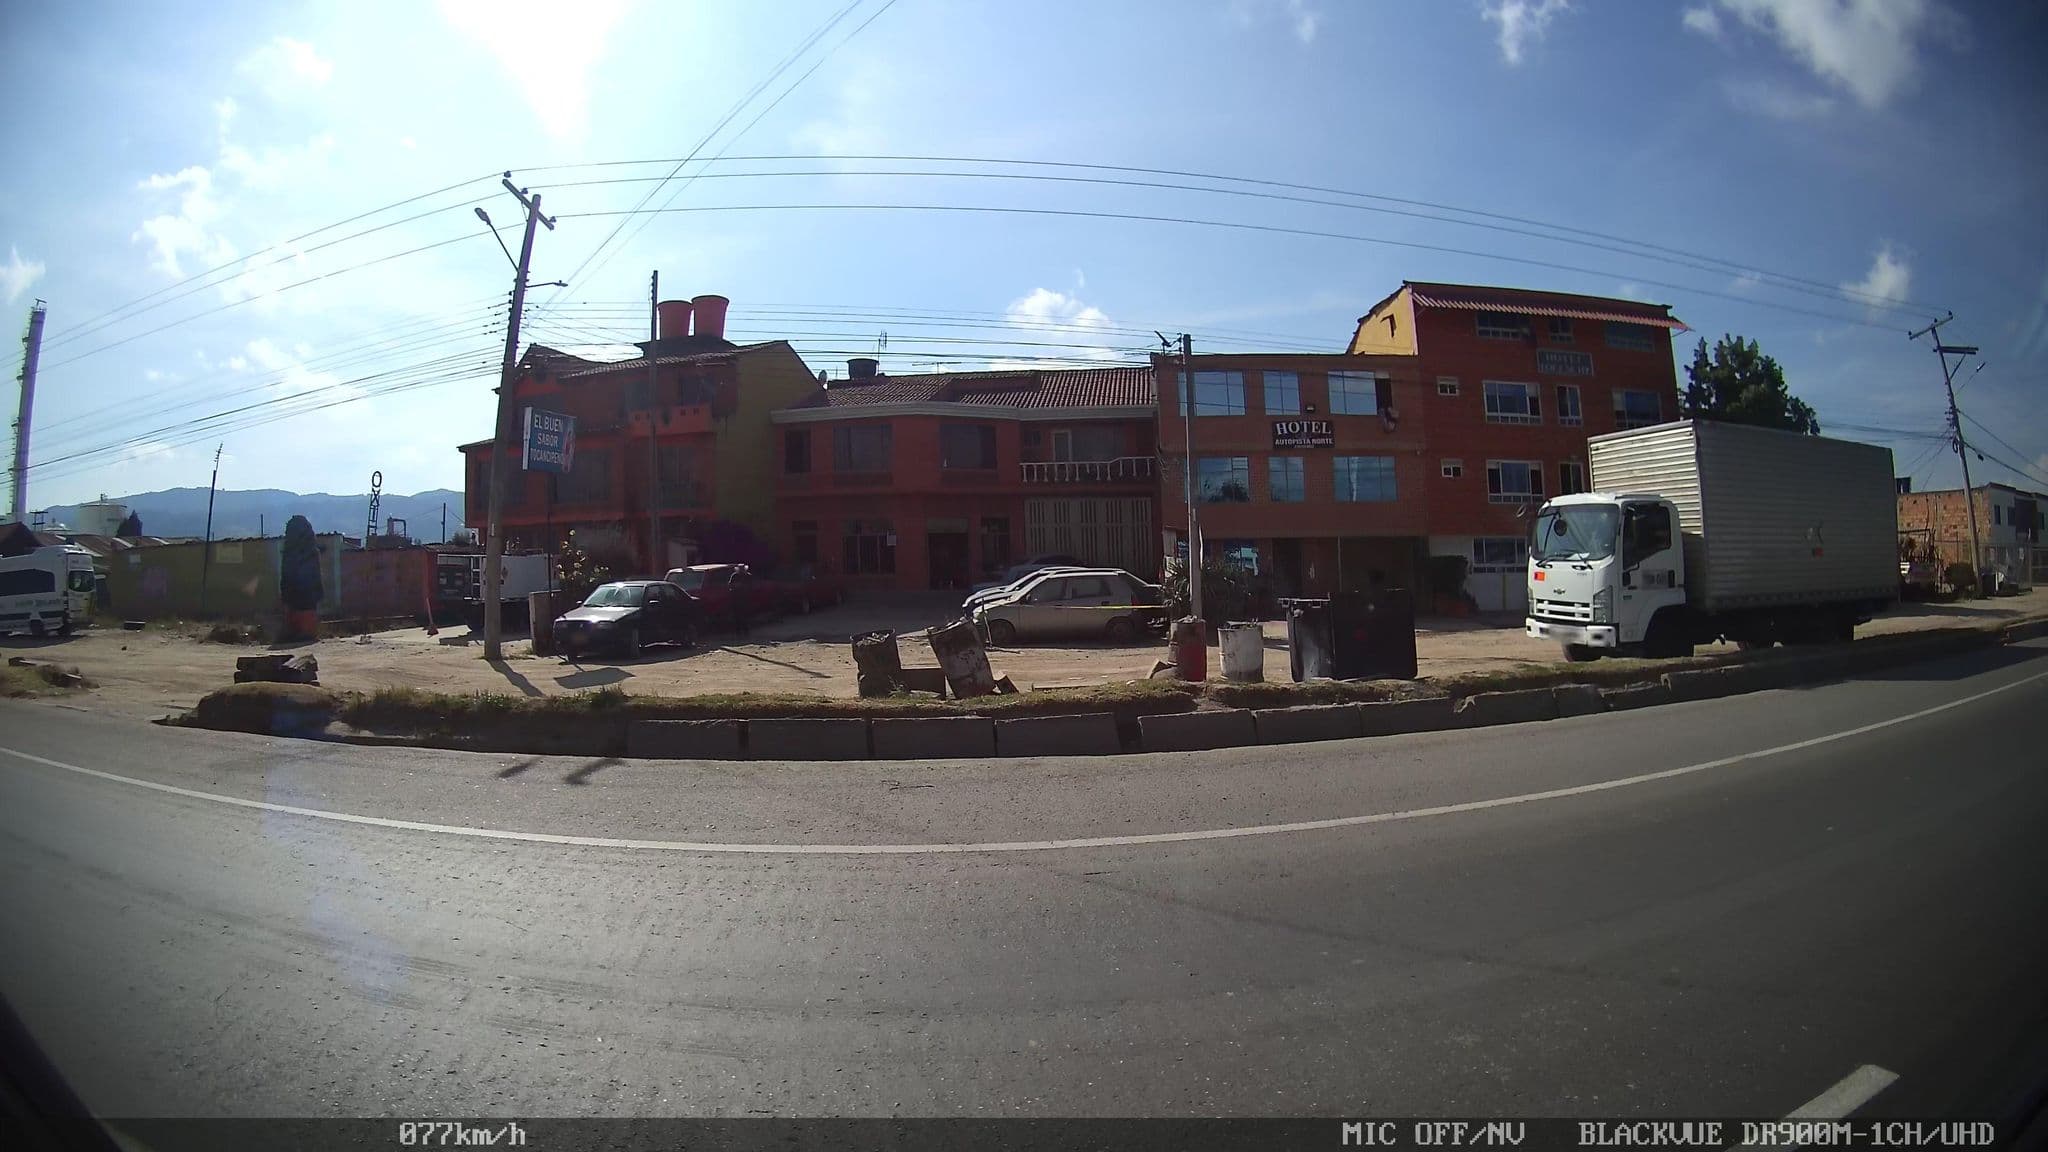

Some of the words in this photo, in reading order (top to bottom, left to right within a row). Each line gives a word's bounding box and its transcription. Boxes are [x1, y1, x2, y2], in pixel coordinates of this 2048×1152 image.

[534, 414, 543, 430] EL
[544, 416, 563, 432] BUEN
[1276, 421, 1331, 435] HOTEL
[537, 433, 559, 447] SABOR
[1275, 438, 1311, 446] AUTOPISTA
[1312, 438, 1333, 446] NORTE
